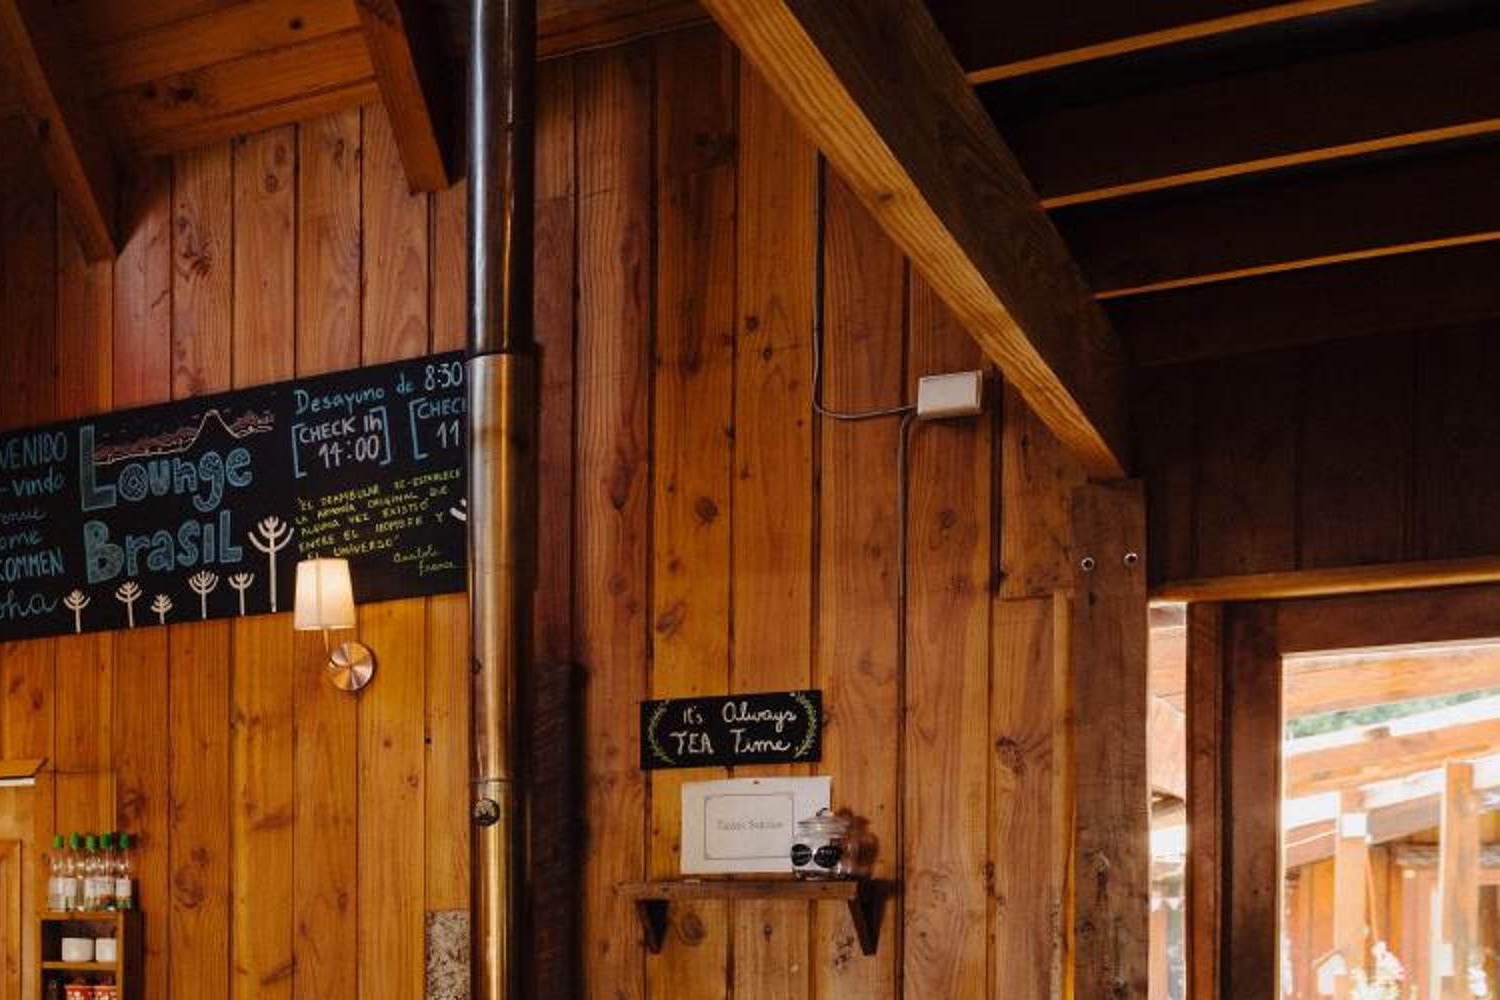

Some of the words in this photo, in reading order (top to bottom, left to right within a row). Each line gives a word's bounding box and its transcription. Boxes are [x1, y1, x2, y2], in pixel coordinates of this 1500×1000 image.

[292, 386, 386, 415] Desayuno
[395, 373, 415, 395] de
[423, 360, 464, 392] 8:30
[416, 397, 468, 419] CHEC
[78, 423, 253, 514] Lounge
[721, 701, 798, 732] Always
[669, 730, 716, 756] TEA
